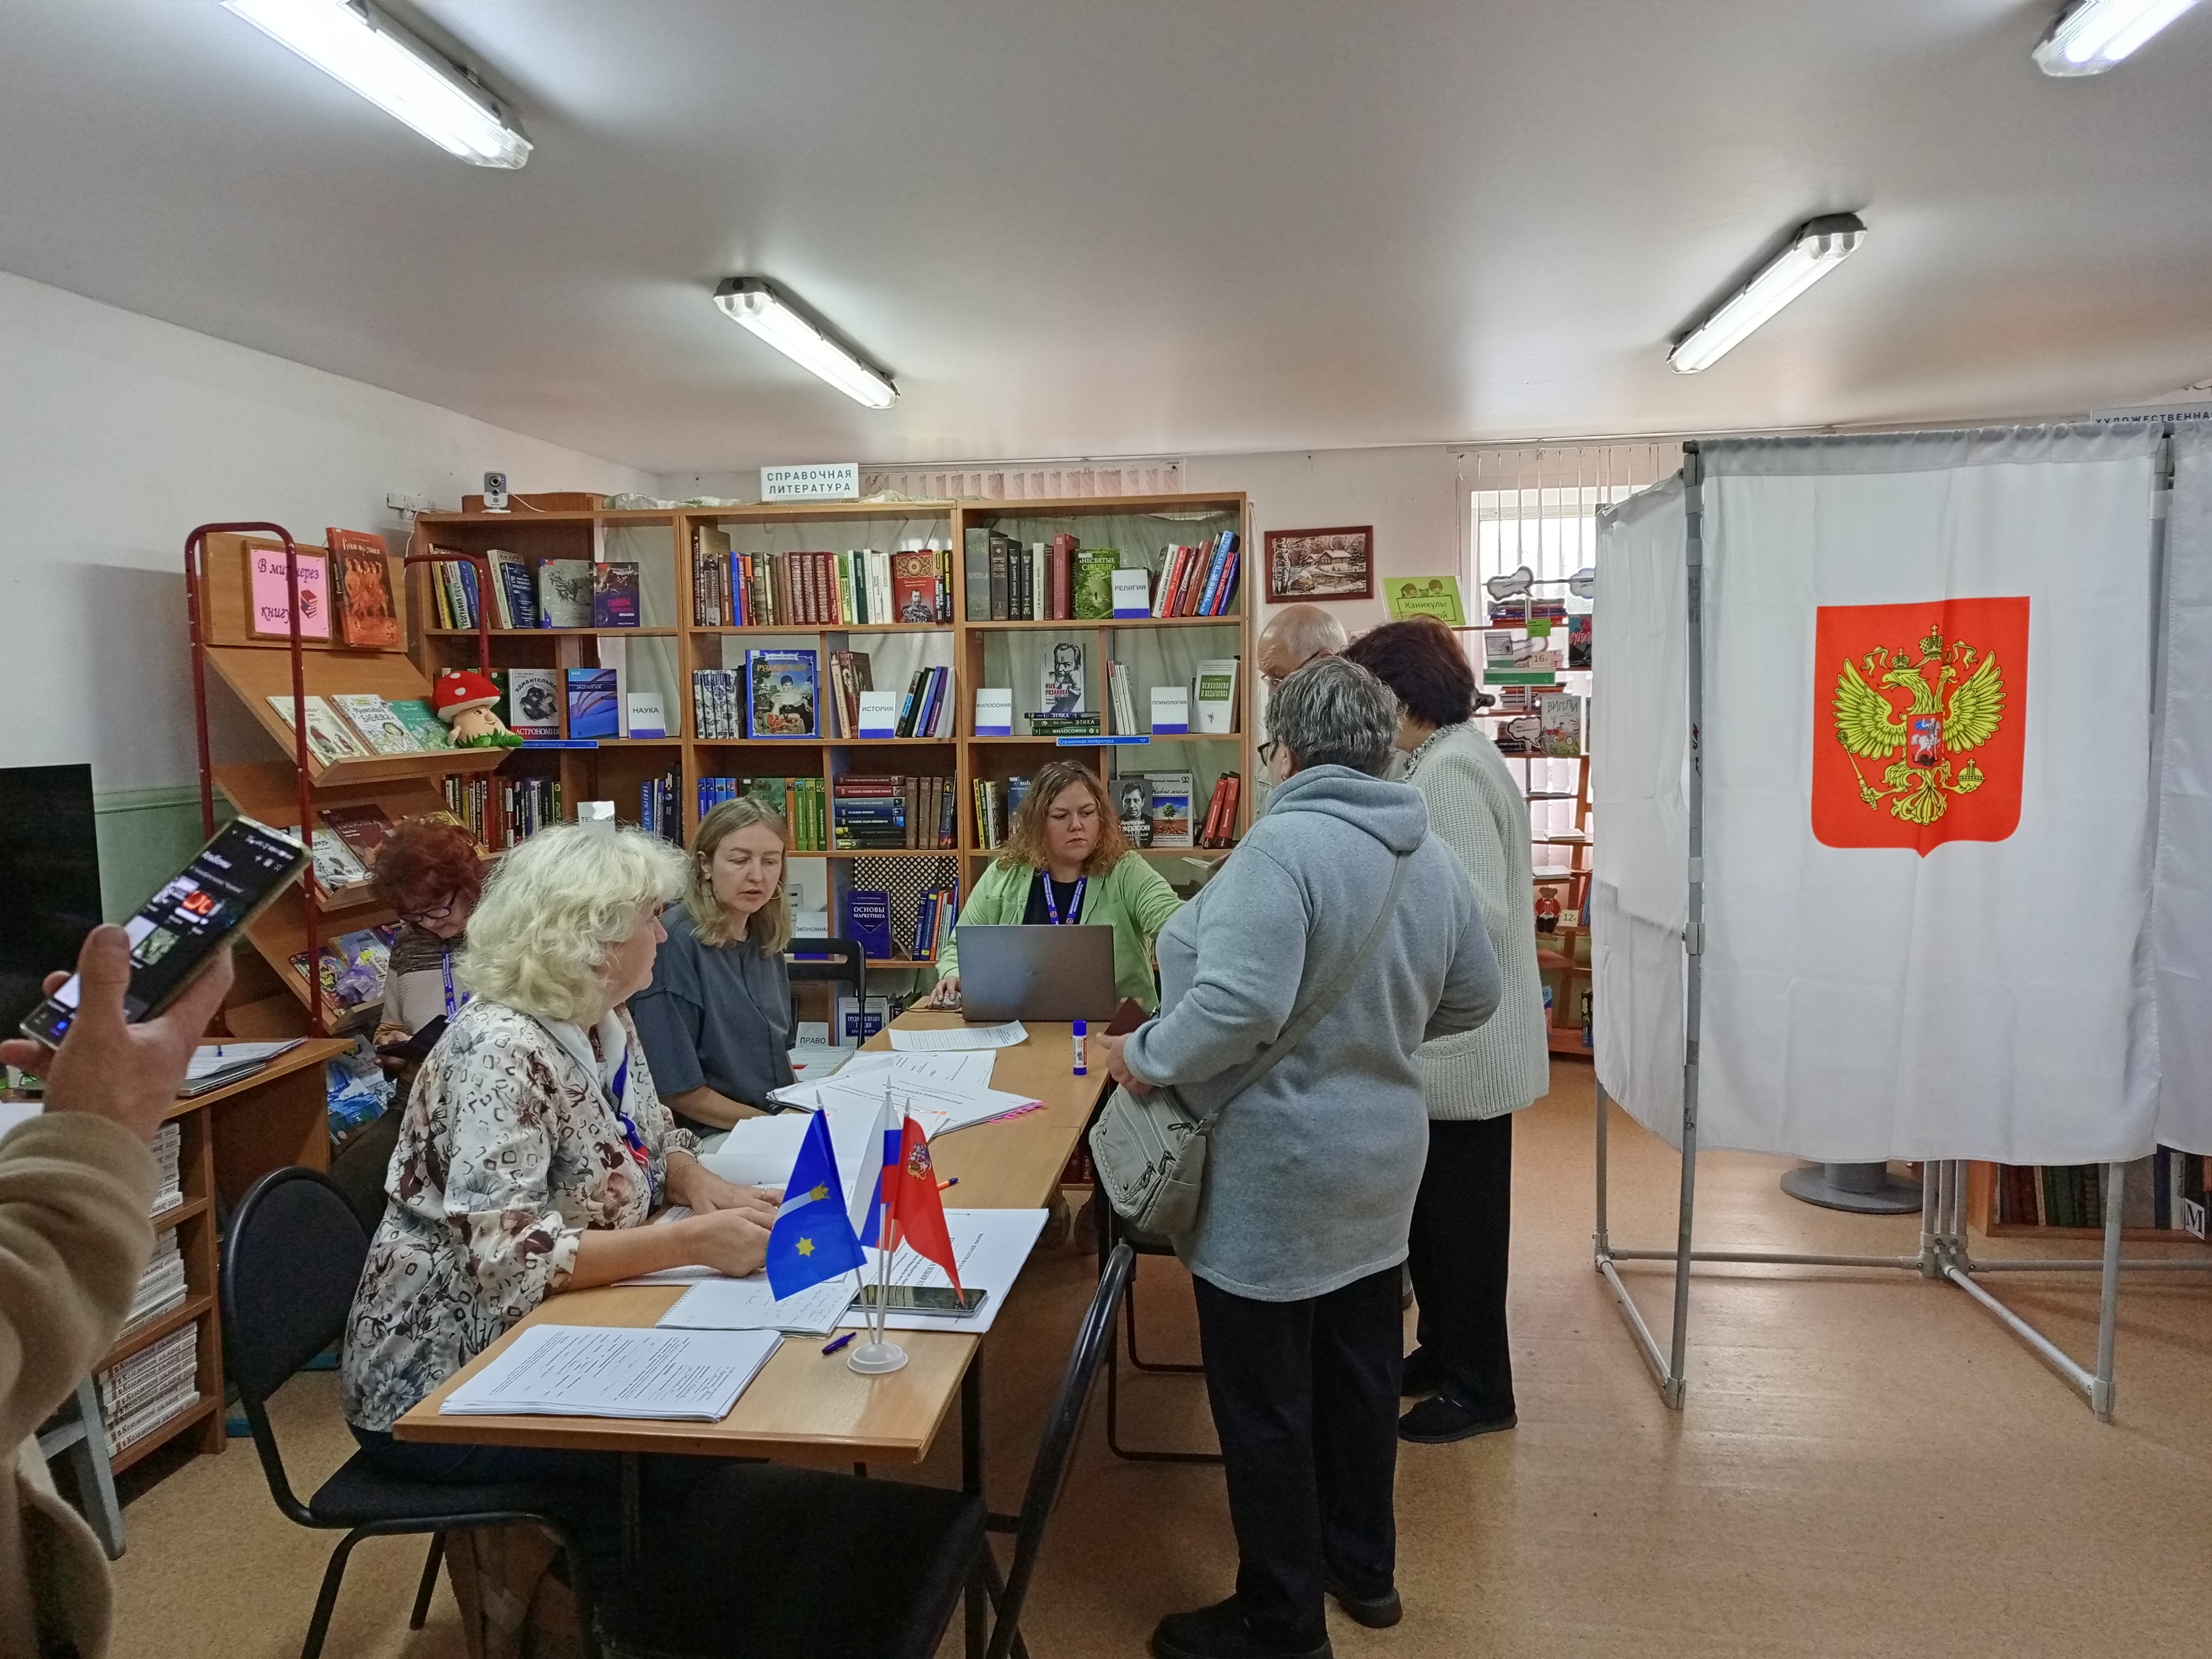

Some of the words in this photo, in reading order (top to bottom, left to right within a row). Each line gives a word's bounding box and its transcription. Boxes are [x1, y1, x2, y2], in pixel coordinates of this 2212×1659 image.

[2096, 412, 2212, 423] ХУДОЖЕСТВЕННА
[767, 470, 852, 481] СПРАВОЧНАЯ
[769, 483, 851, 494] ЛИТЕРАТУРА
[258, 559, 266, 572] В
[270, 564, 288, 580] ми
[1115, 584, 1146, 592] РЕЛИГИЯ
[457, 598, 468, 626] ГЕОГРАФИЯ
[1548, 700, 1577, 713] ВИЛЛИ
[1563, 913, 1576, 923] 12+
